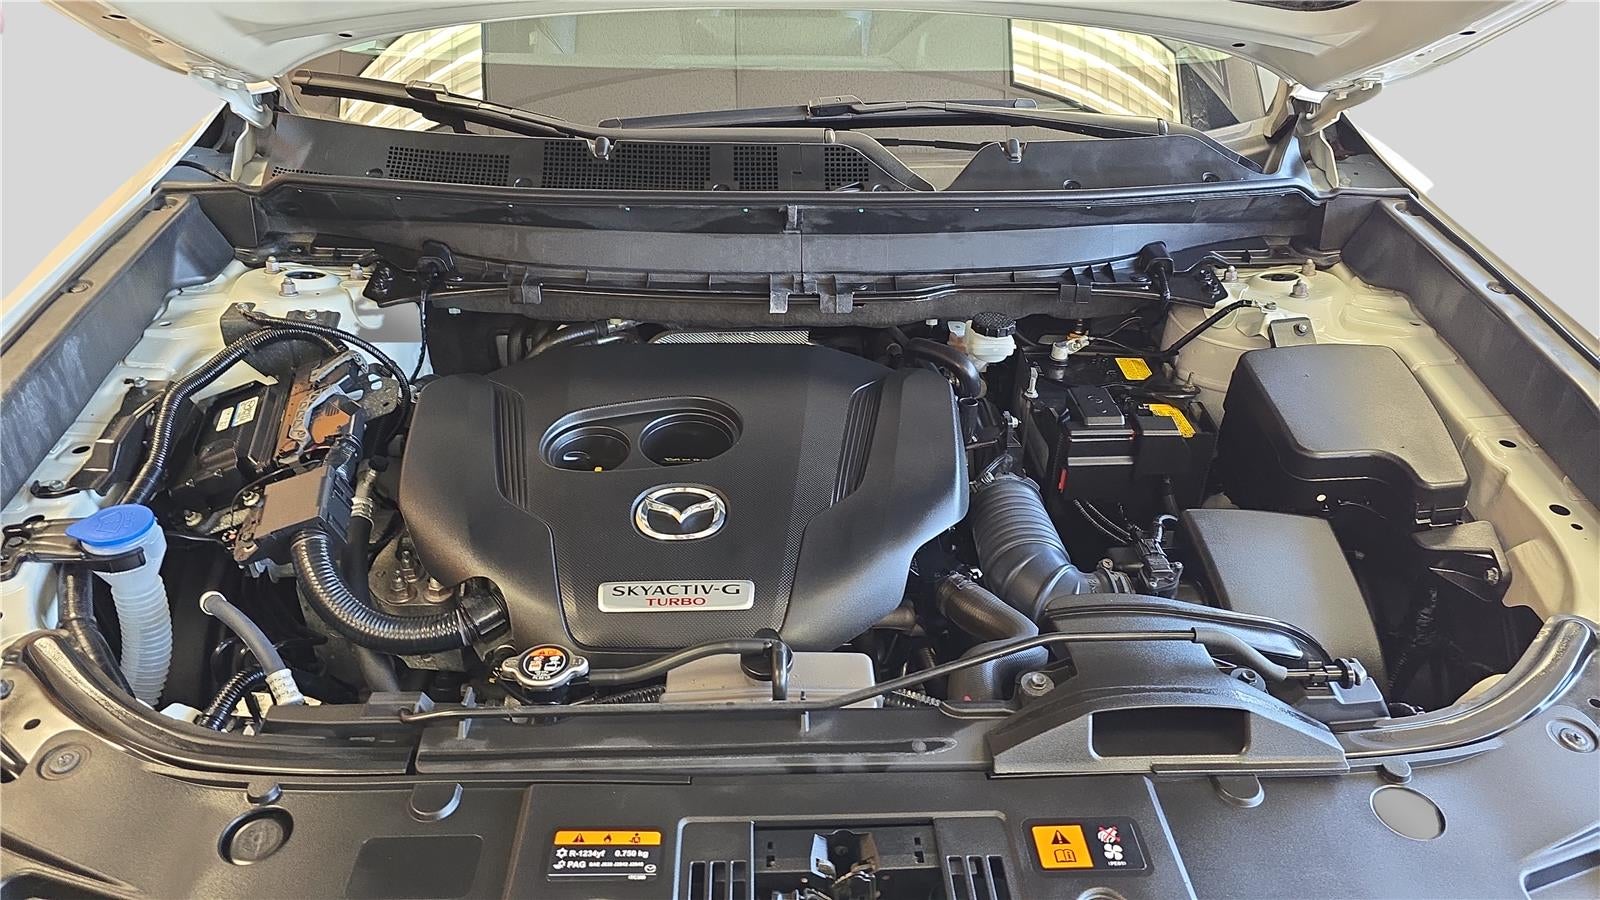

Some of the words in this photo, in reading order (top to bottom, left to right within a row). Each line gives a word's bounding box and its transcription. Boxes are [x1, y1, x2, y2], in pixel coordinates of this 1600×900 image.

[612, 584, 741, 597] SKYACTIV-G
[646, 597, 706, 607] TURBO
[568, 849, 606, 859] R-1234yf
[614, 850, 637, 858] 0.750
[638, 850, 649, 859] kg
[566, 861, 587, 869] PAG
